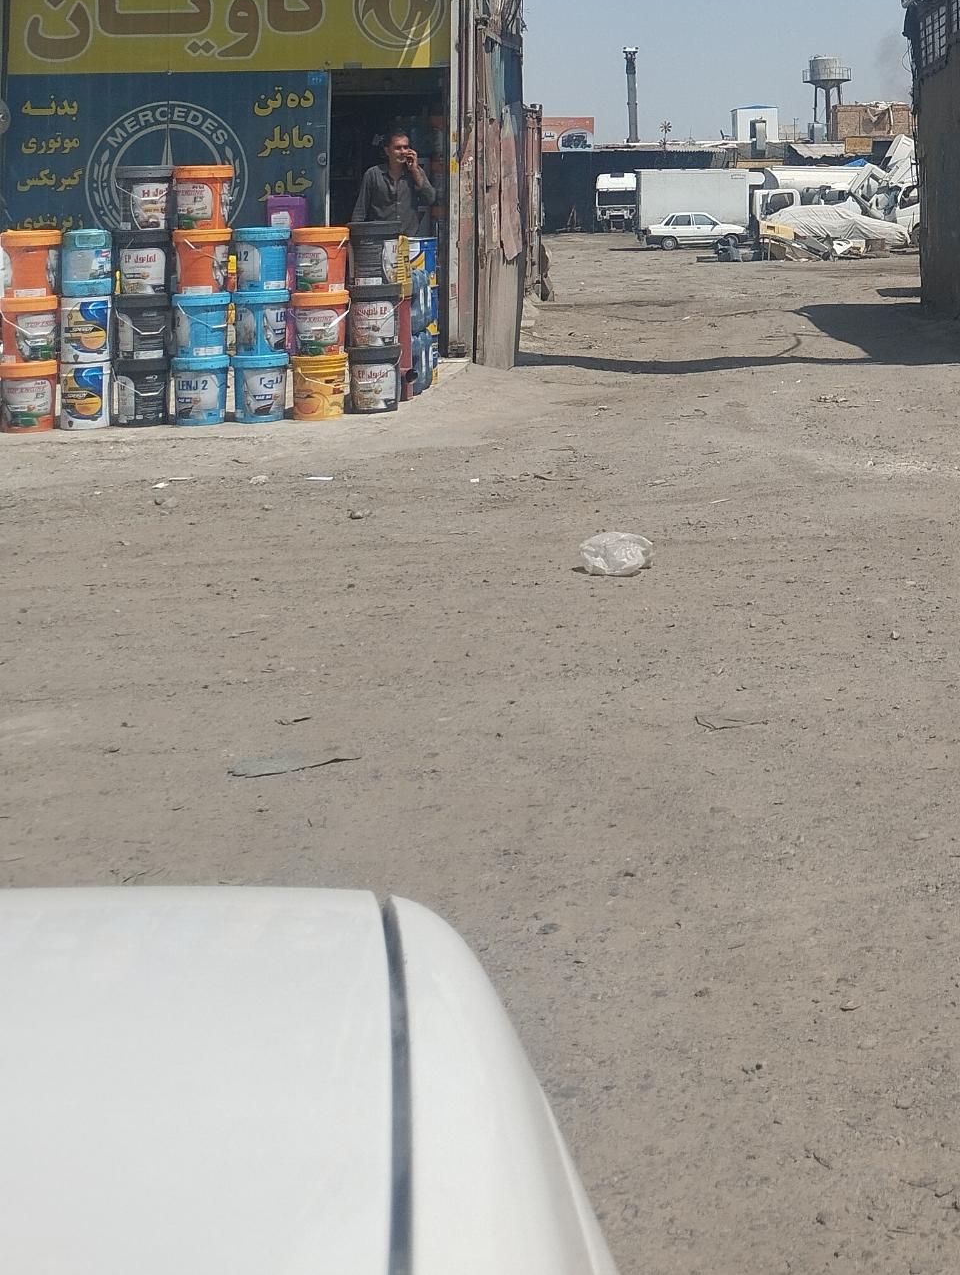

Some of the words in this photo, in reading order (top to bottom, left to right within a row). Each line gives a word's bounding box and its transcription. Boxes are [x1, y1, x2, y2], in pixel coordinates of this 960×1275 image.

[21, 94, 79, 121] بدنه
[254, 85, 283, 117] تن
[286, 89, 315, 109] ده
[106, 104, 229, 148] MERCEDES
[21, 132, 81, 155] موتوری
[256, 125, 315, 158] مایلر
[16, 167, 84, 193] گیربکس
[256, 170, 314, 202] خاور
[178, 379, 199, 392] LENJ
